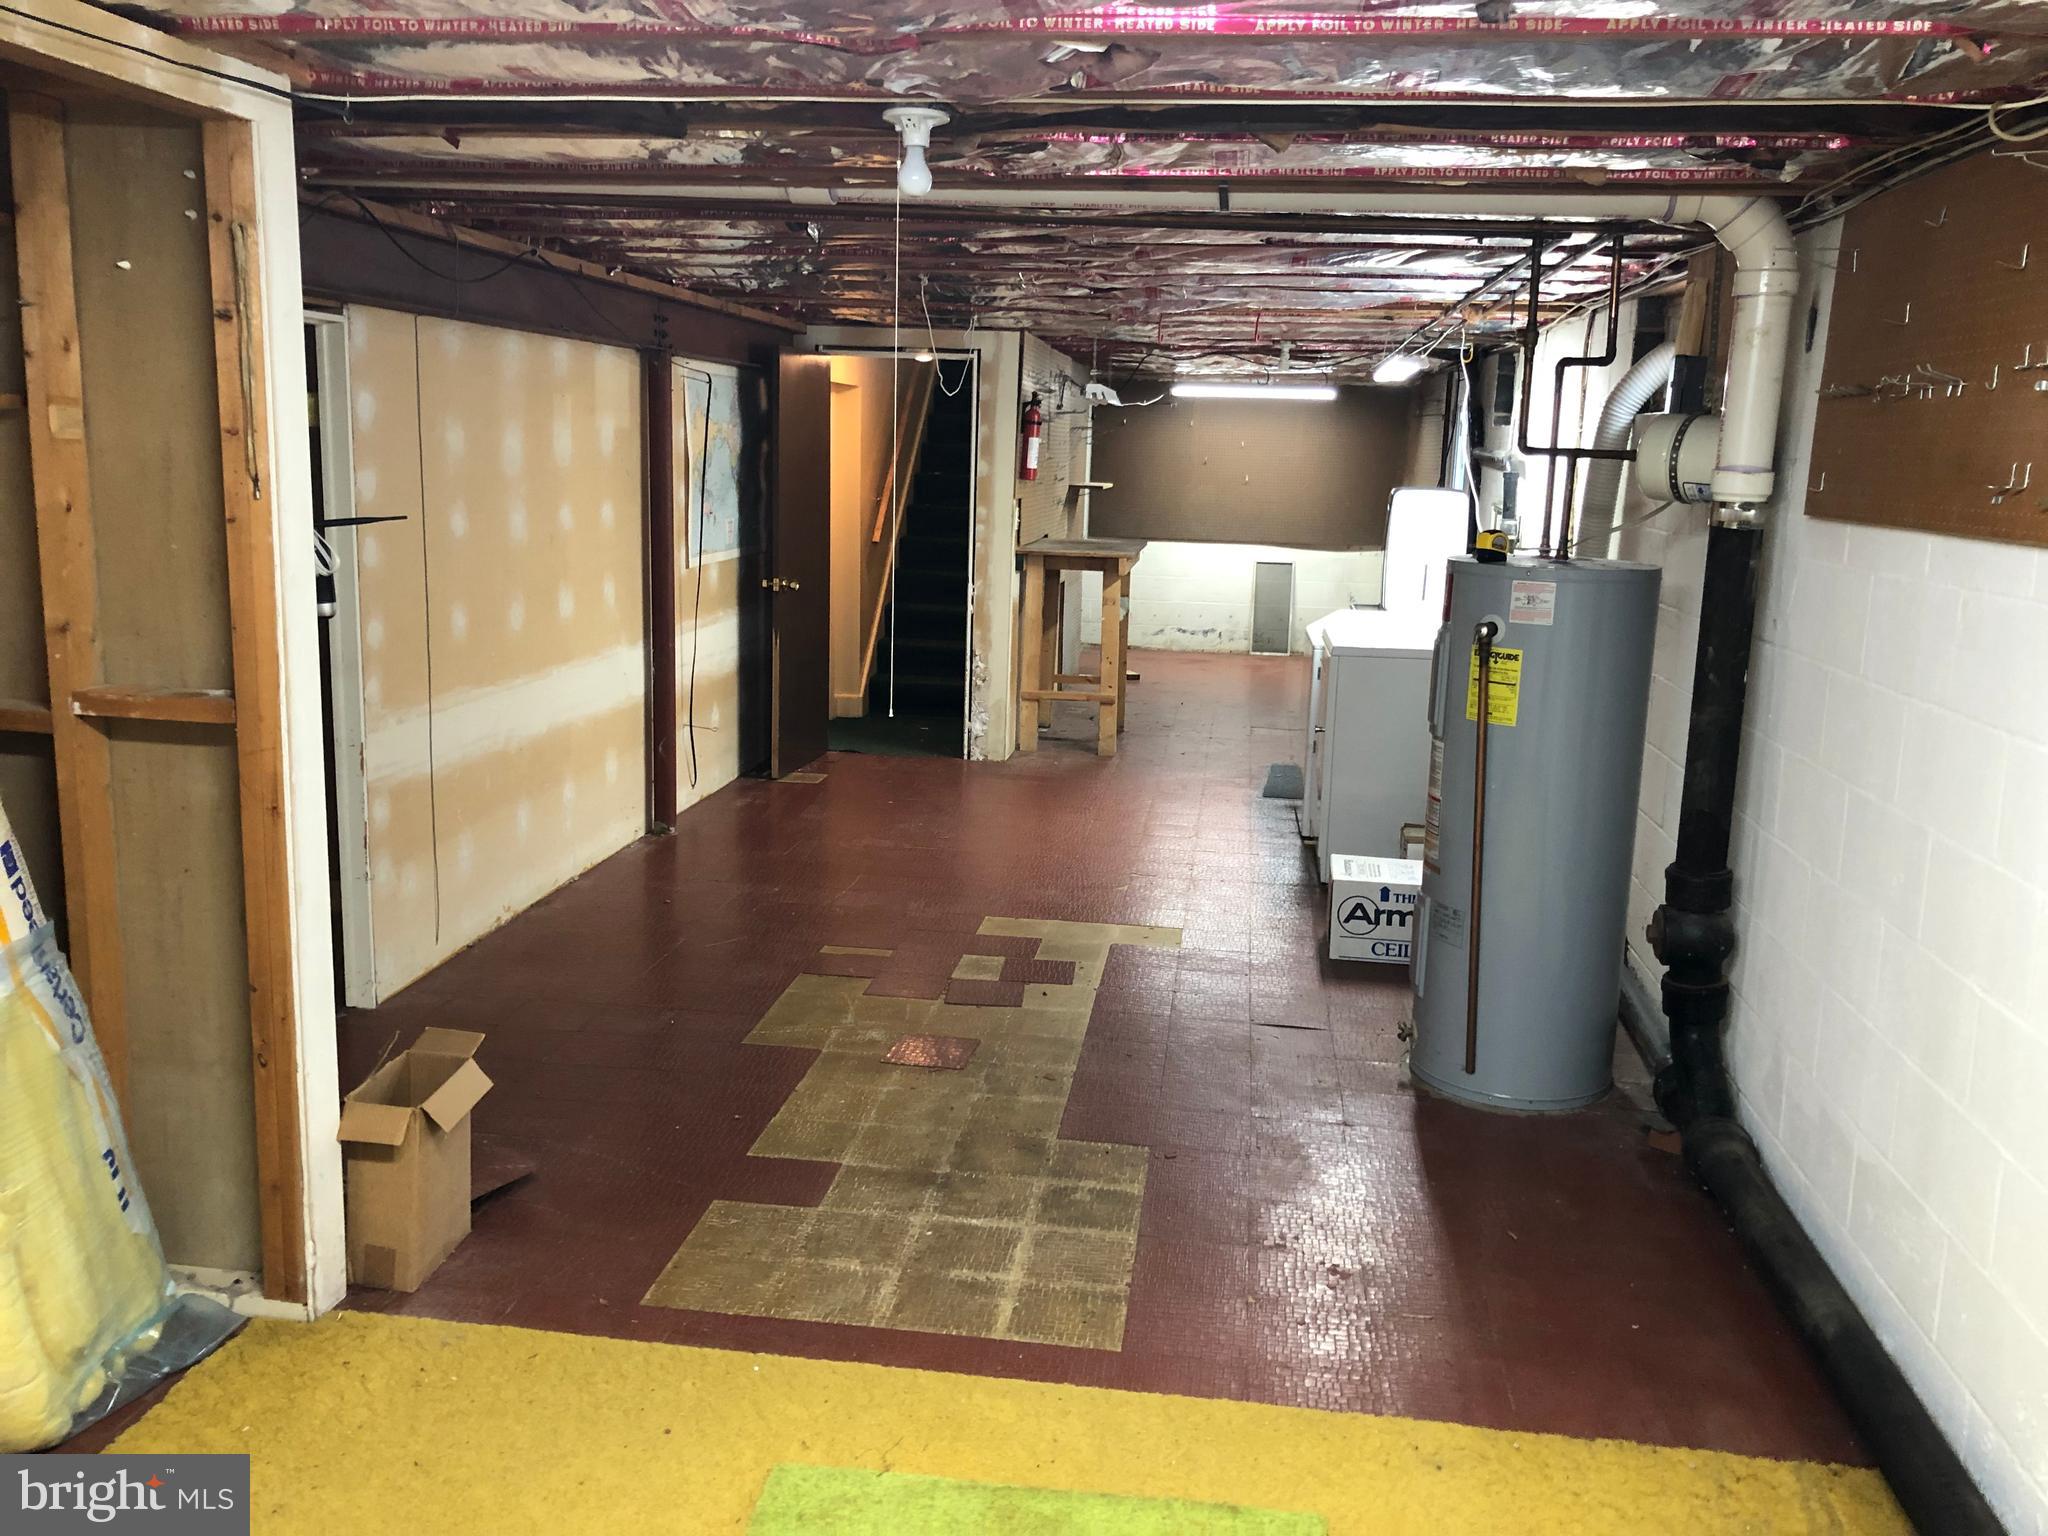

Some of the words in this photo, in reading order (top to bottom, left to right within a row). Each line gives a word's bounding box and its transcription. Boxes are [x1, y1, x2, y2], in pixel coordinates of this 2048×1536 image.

[249, 17, 280, 31] SIDE
[315, 17, 358, 31] APPLY
[364, 18, 396, 32] FOIL
[400, 19, 419, 32] TO
[424, 18, 481, 32] WINTER
[489, 19, 542, 33] HEATED
[1043, 17, 1103, 29] WINTER
[1114, 18, 1173, 31] HEATED
[1179, 18, 1216, 31] SIDE
[1255, 19, 1303, 32] APPLY
[1312, 19, 1349, 31] FOIL
[1355, 20, 1375, 31] TO
[1381, 18, 1444, 31] WINTER
[1525, 19, 1563, 31] SIDE
[1606, 18, 1658, 31] APPLY
[1668, 19, 1706, 31] FOIL
[1712, 20, 1733, 31] TO
[1741, 19, 1808, 31] WINTER
[1893, 20, 1933, 33] SIDE
[1491, 134, 1538, 144] HEATED
[1601, 136, 1641, 147] APPLY
[1374, 167, 1408, 177] APPLY
[1411, 167, 1436, 177] FOIL
[1440, 167, 1454, 177] TO
[1457, 167, 1500, 177] WINTER
[1507, 169, 1549, 178] HEATED
[1645, 170, 1672, 179] FOIL
[1675, 171, 1690, 179] TO
